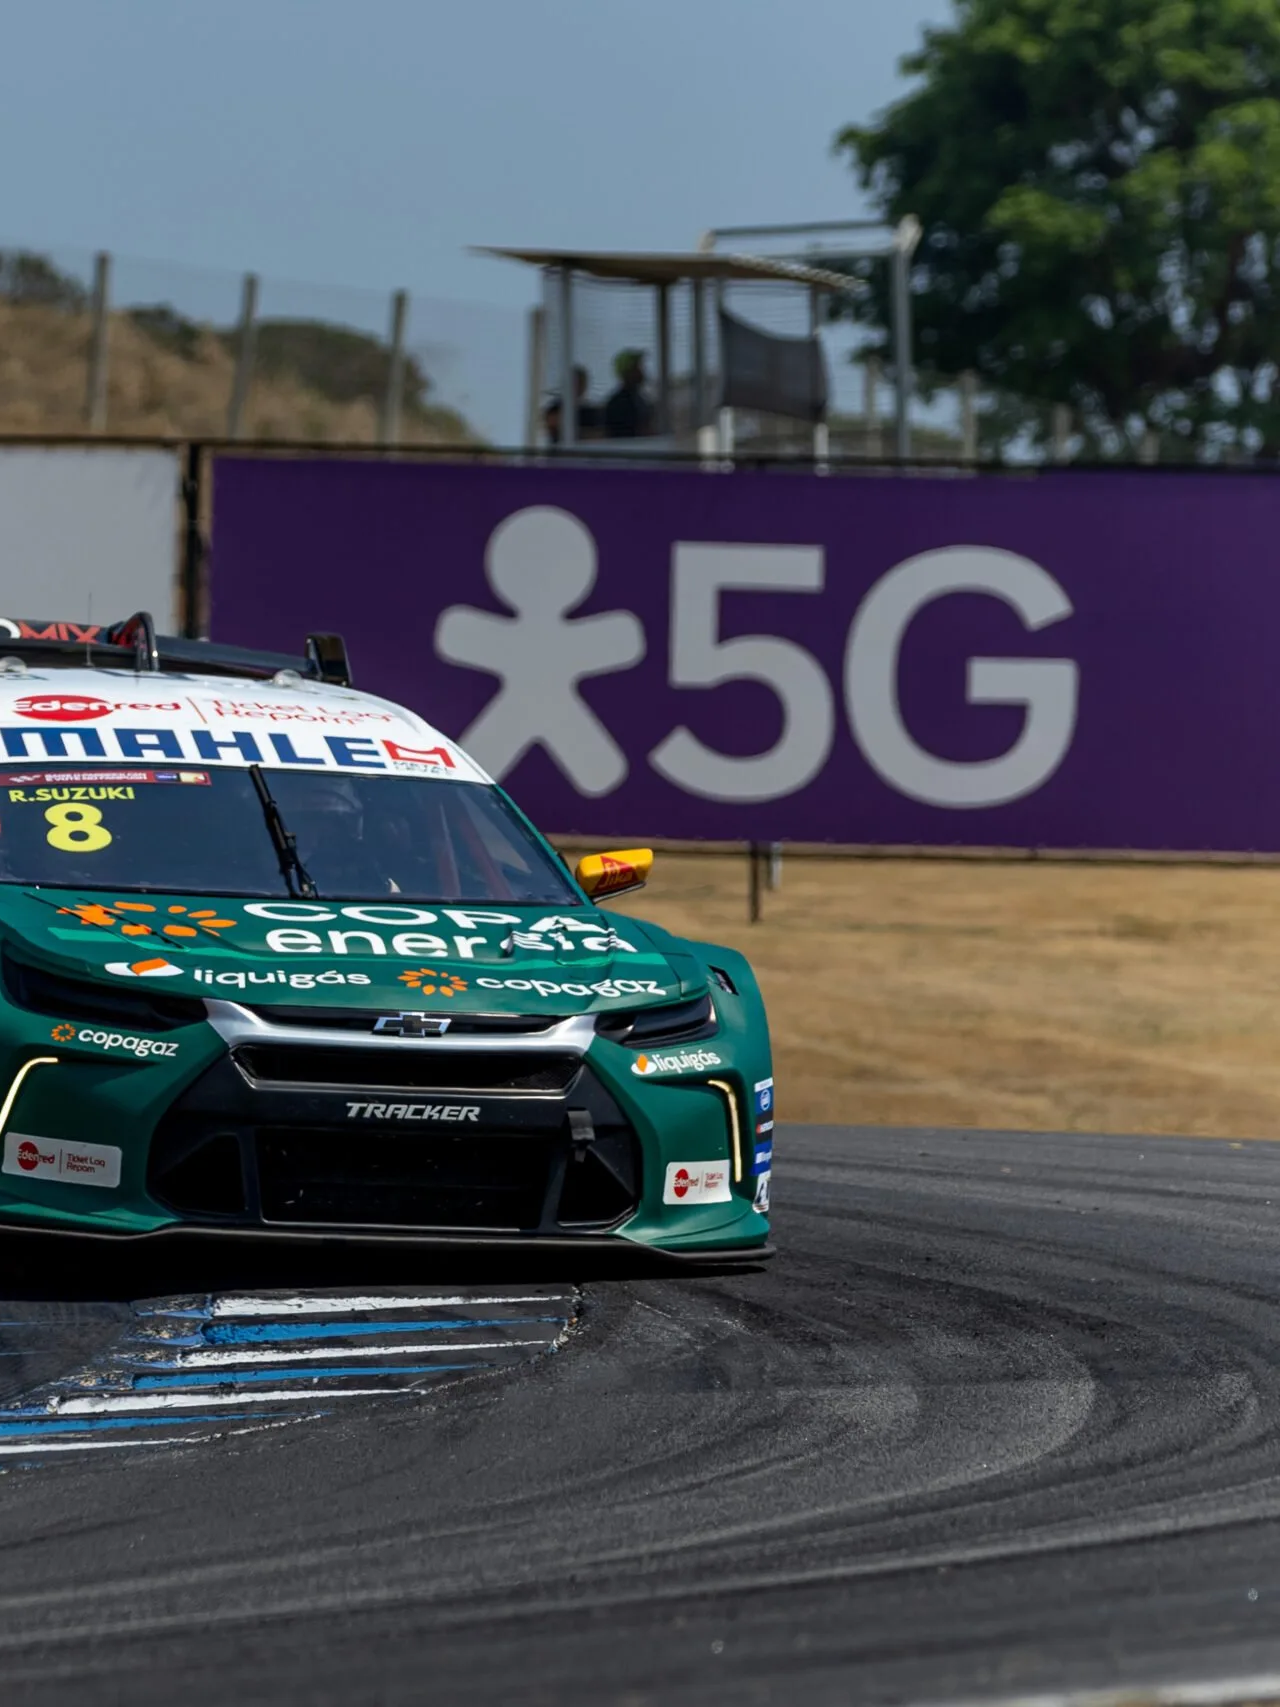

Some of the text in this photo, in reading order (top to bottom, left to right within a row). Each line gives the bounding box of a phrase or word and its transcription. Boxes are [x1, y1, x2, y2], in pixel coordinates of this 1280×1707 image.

[647, 540, 1080, 810] 5G
[13, 697, 182, 716] Edenred
[0, 727, 386, 768] MAHLE
[8, 787, 136, 802] R.SUZUKI
[44, 802, 113, 853] 8
[243, 903, 609, 933] COPA
[193, 968, 372, 989] liquigás
[476, 976, 667, 998] copagaz
[78, 1029, 180, 1057] copagaz
[651, 1049, 722, 1074] liquigás
[346, 1102, 481, 1122] TRACKER
[18, 1148, 56, 1165] Edenred
